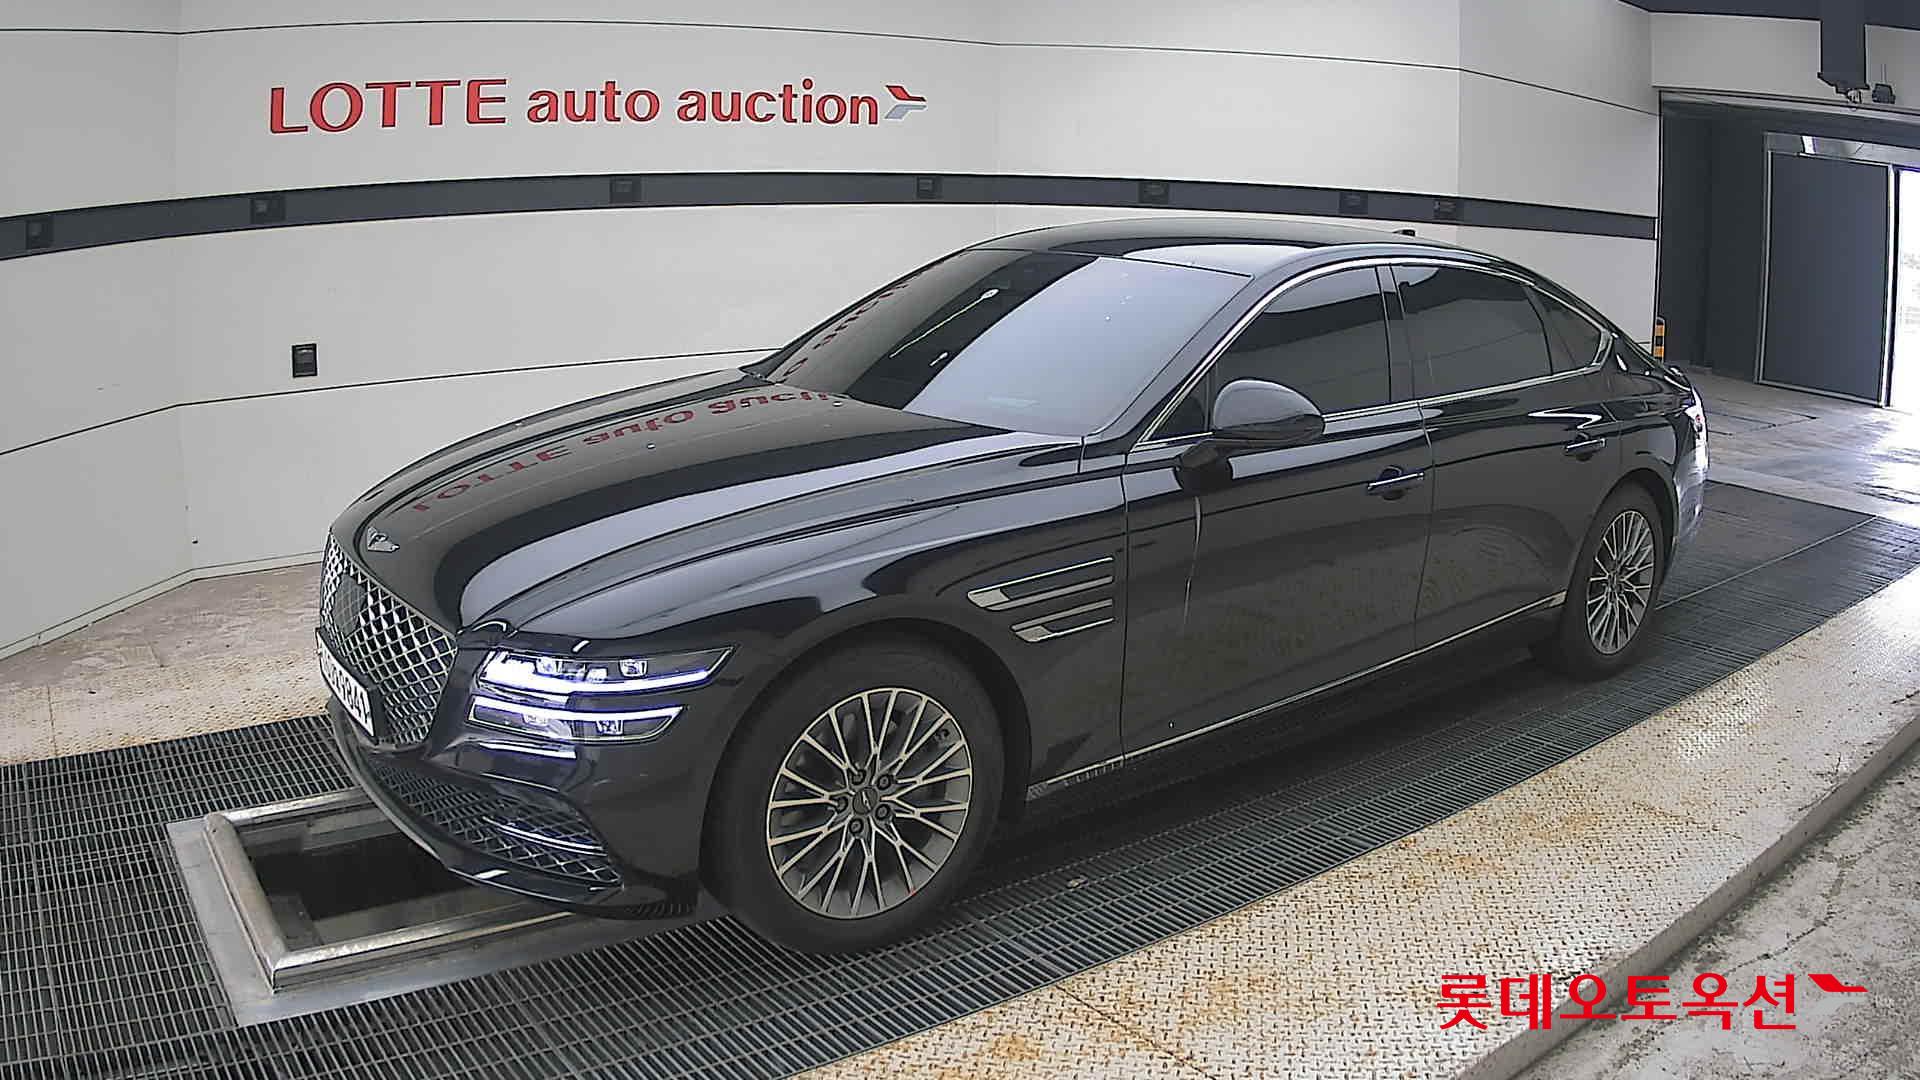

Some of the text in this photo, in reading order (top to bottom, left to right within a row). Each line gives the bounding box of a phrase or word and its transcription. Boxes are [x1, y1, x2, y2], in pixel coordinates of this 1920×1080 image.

[270, 79, 879, 134] LOTTE auto auction
